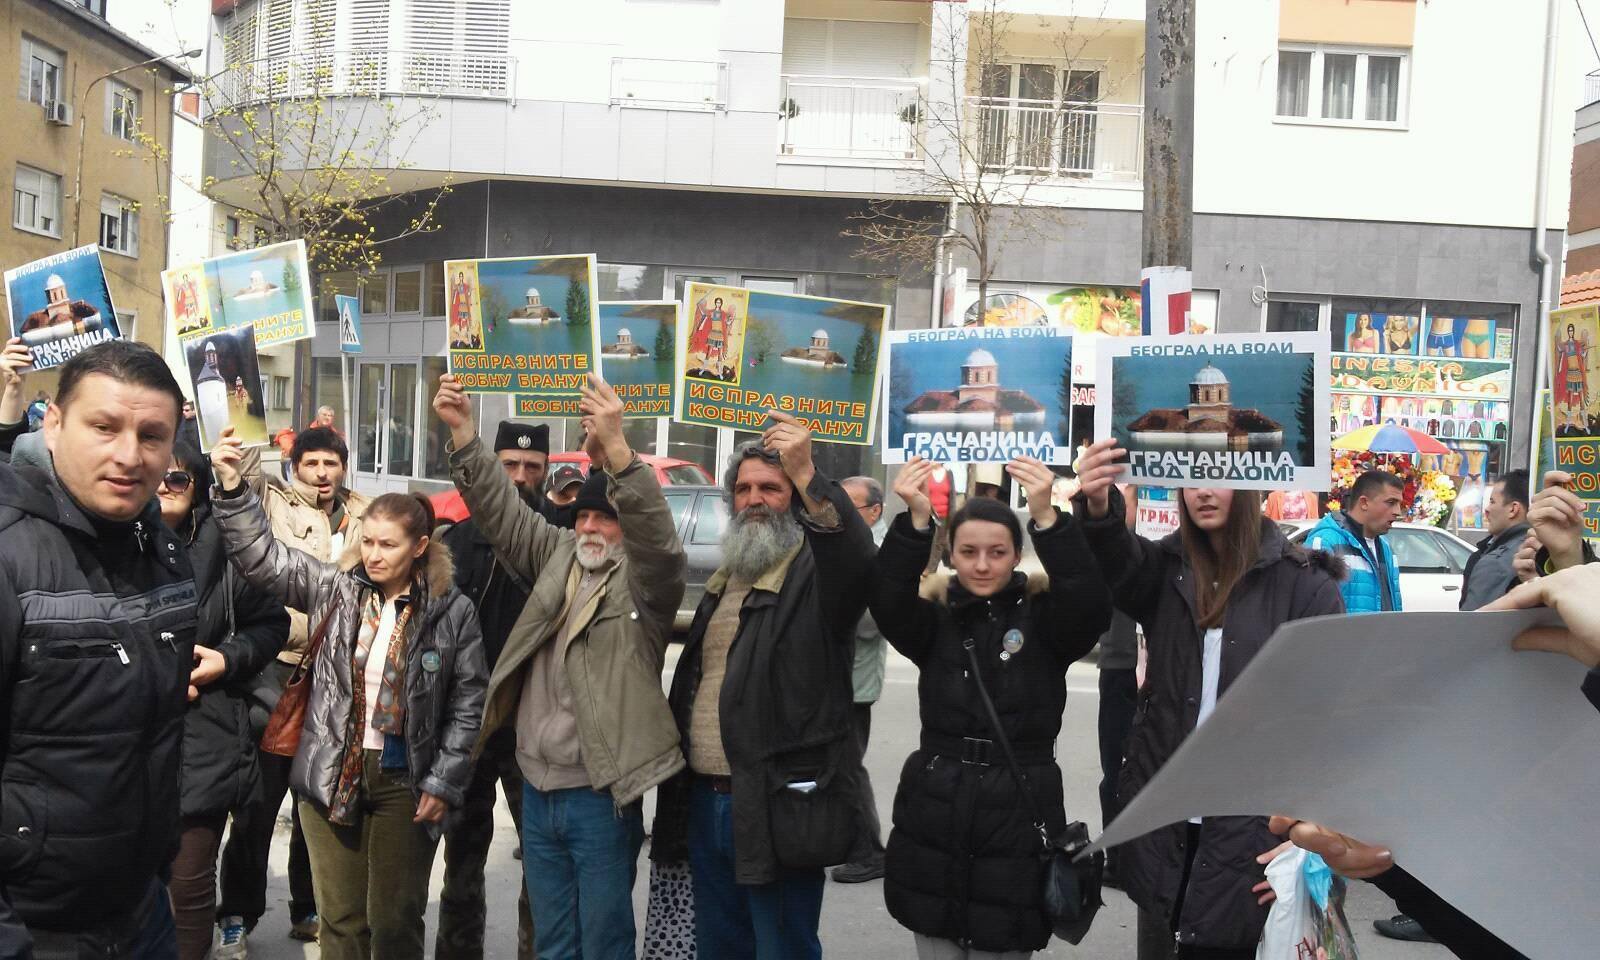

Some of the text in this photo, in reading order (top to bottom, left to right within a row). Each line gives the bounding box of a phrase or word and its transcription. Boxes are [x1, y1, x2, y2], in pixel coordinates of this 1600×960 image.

[908, 327, 1058, 343] БЕОГРАД НА ВОДИ
[1130, 342, 1294, 357] БЕОГРАД НА ВОДИ
[453, 353, 589, 369] ИСПРАЗНИТЕ
[453, 374, 589, 389] КОБНУ БРАНУ!
[521, 400, 582, 413] КОБН
[689, 383, 867, 418] ИСПРАЗНИТЕ
[688, 403, 769, 427] КОБНУ
[902, 431, 1056, 449] ГРАЧАНИЦА
[903, 447, 1055, 463] ПОД ВОДОМ!
[1128, 450, 1297, 468] ГРАЧАНИЦА
[1559, 444, 1600, 465] ИС
[1130, 463, 1295, 482] ПОД ВОДОМ!
